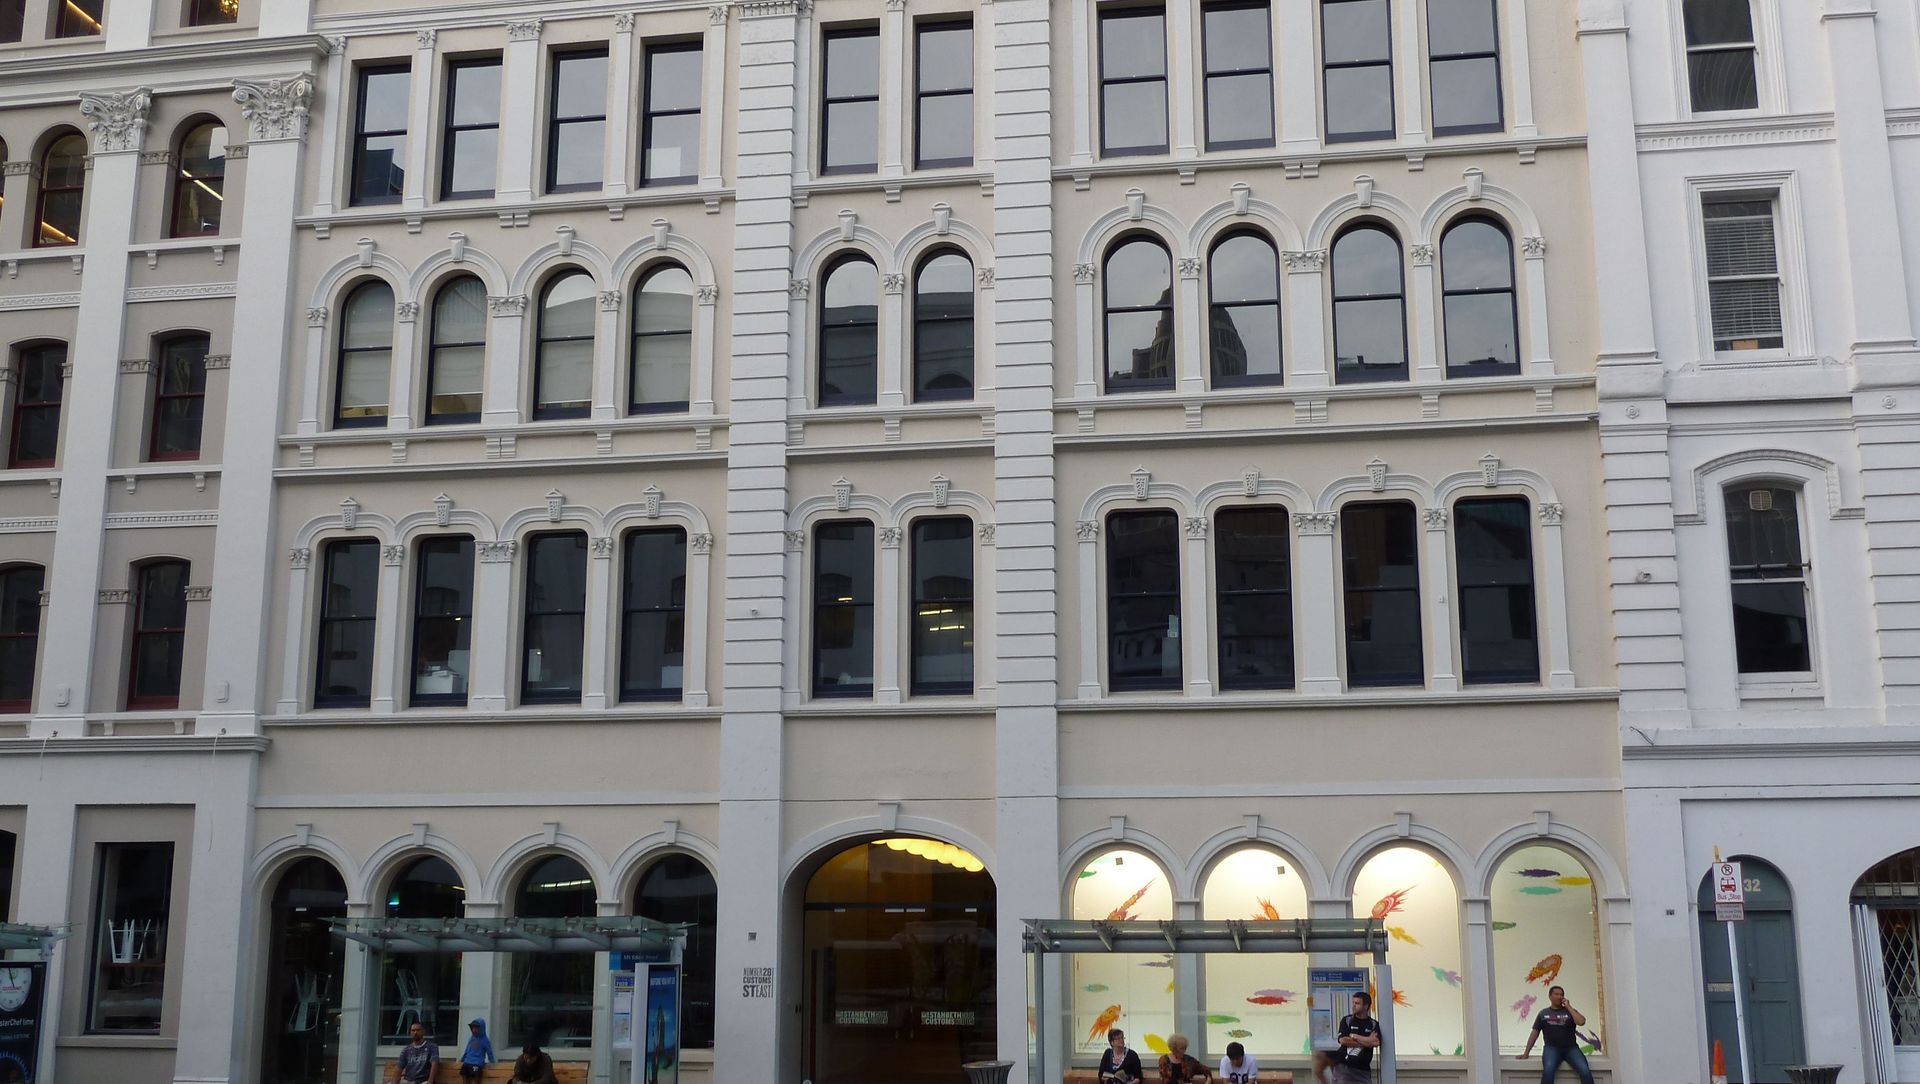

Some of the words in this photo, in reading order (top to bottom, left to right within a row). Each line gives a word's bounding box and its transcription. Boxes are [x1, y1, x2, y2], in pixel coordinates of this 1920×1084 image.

[1743, 879, 1761, 892] 32
[743, 968, 762, 976] NUMBER
[763, 968, 772, 976] 28
[925, 1018, 955, 1026] CUSTOMS
